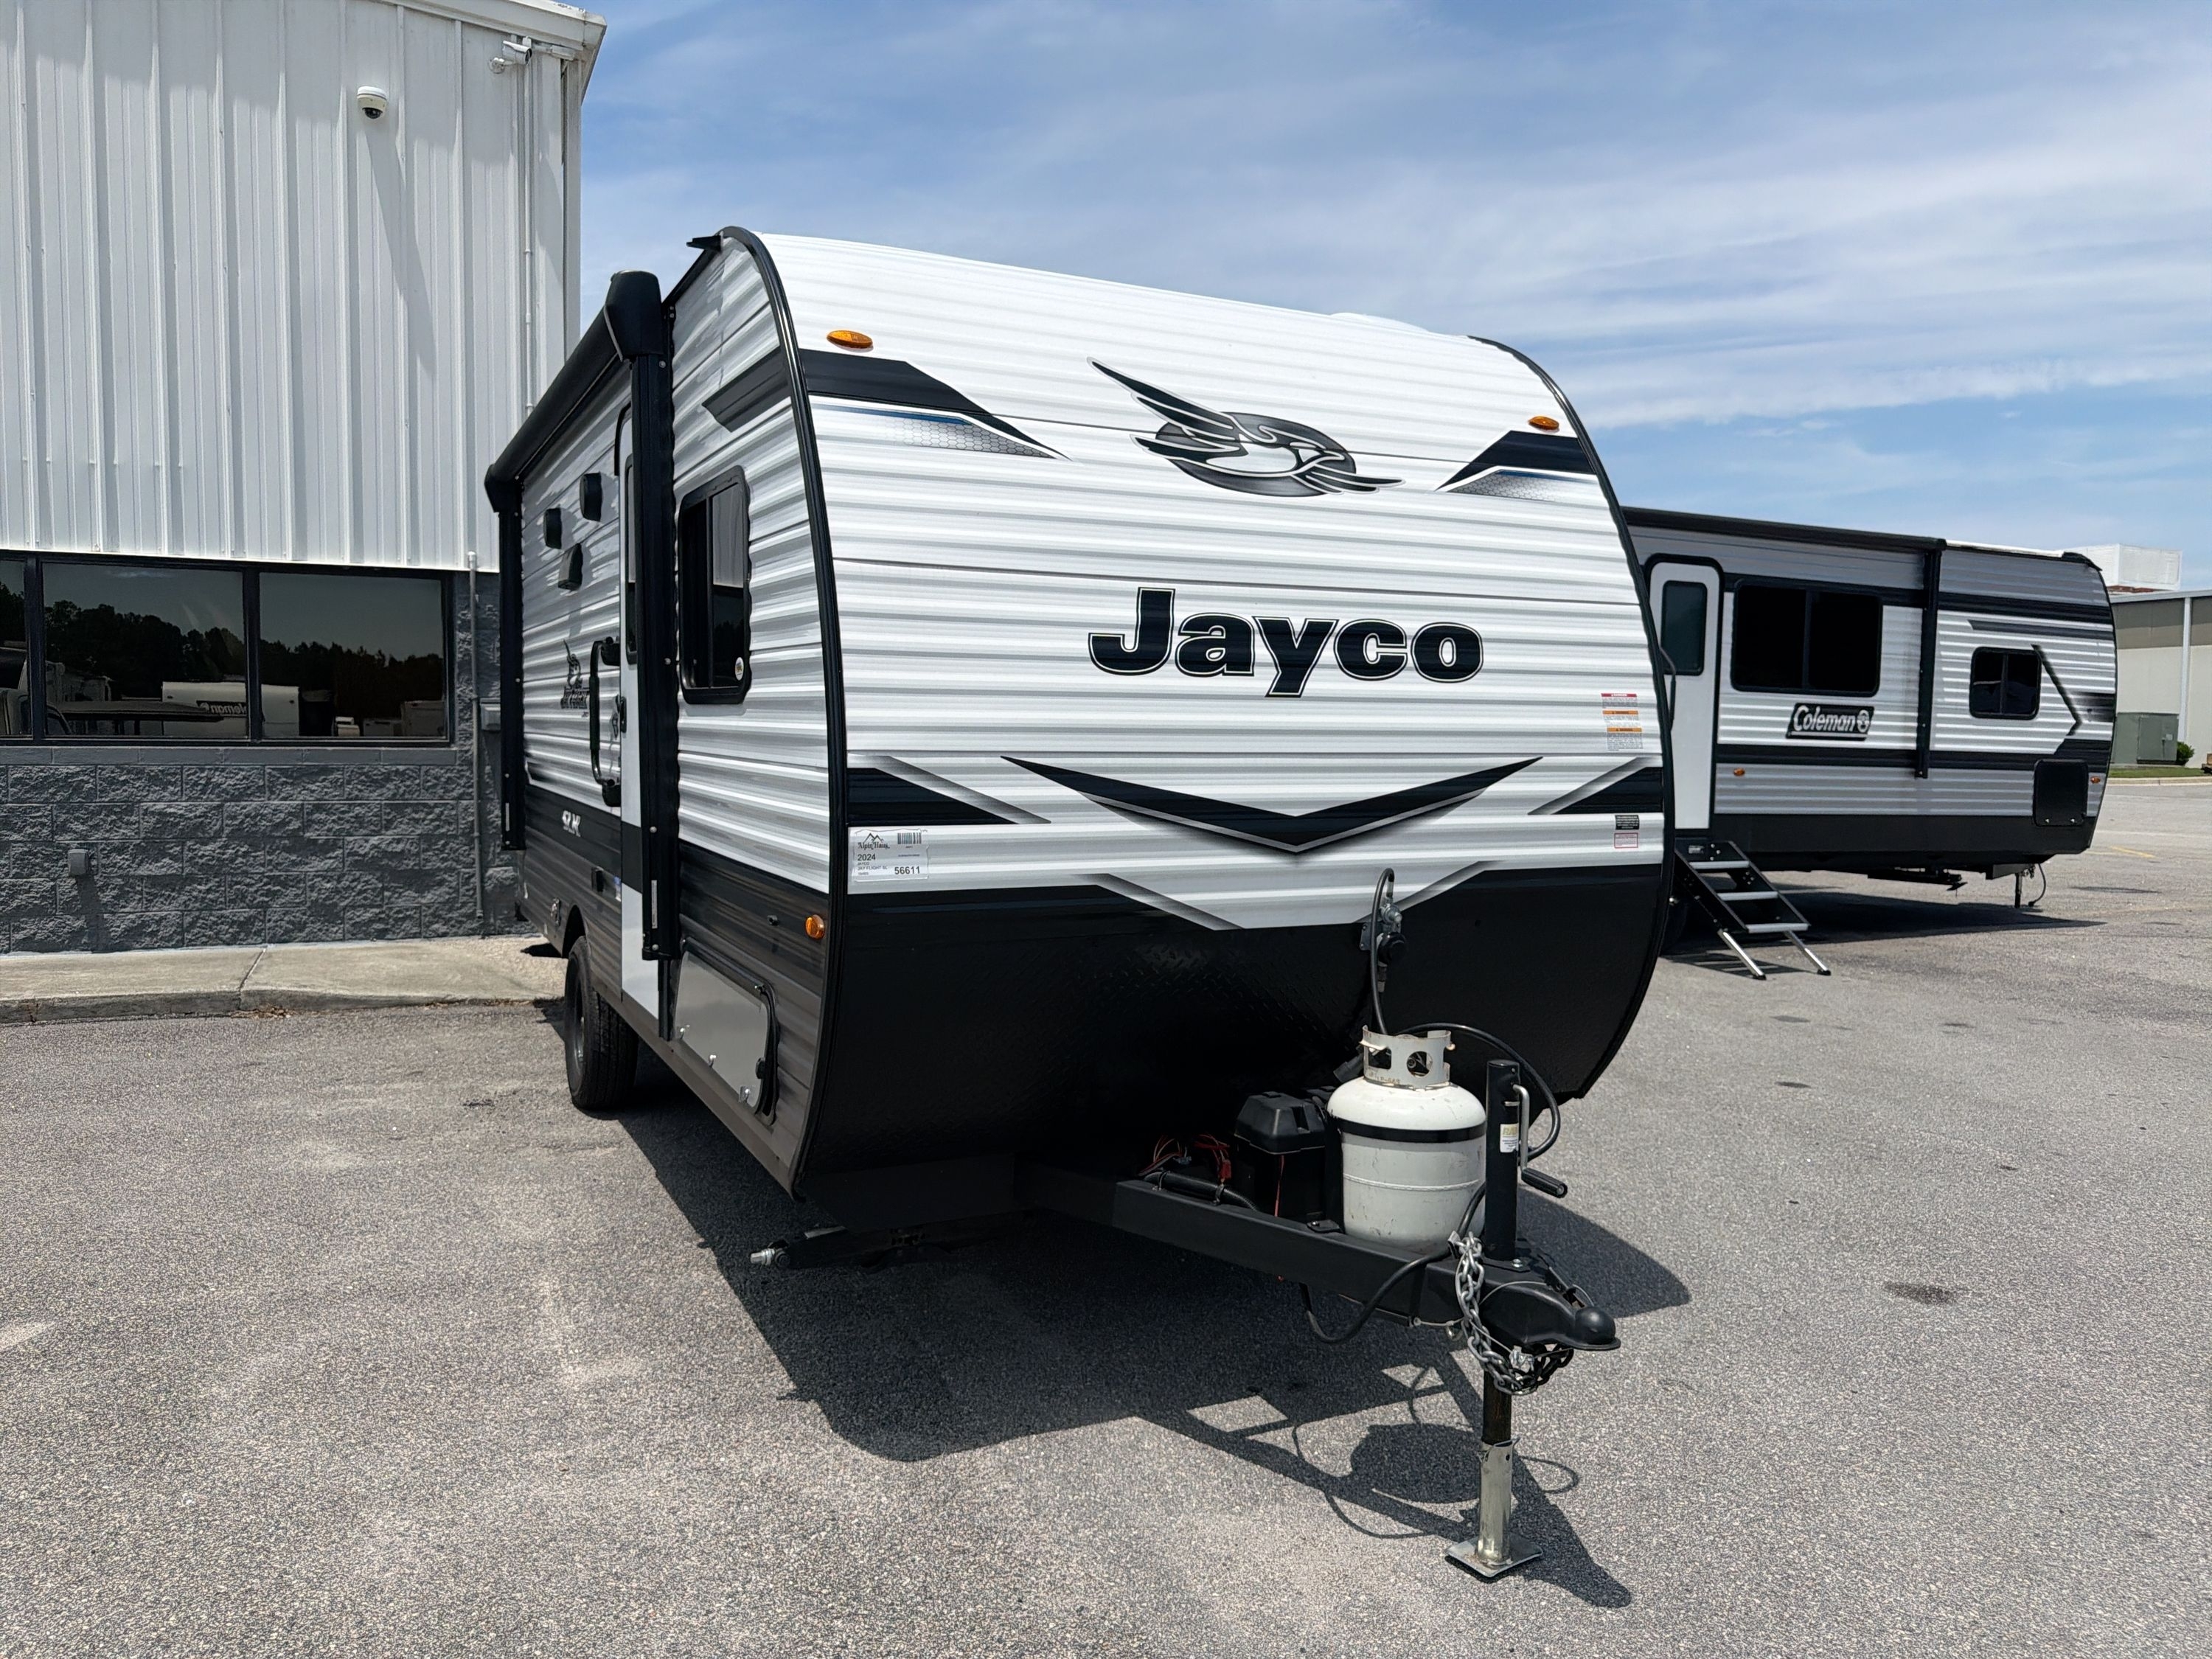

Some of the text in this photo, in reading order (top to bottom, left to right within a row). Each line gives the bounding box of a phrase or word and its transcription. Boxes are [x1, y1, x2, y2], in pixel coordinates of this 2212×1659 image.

[1088, 587, 1484, 698] Jayco
[1793, 705, 1855, 731] Coleman
[858, 853, 876, 861] 2024
[894, 866, 920, 875] 56611
